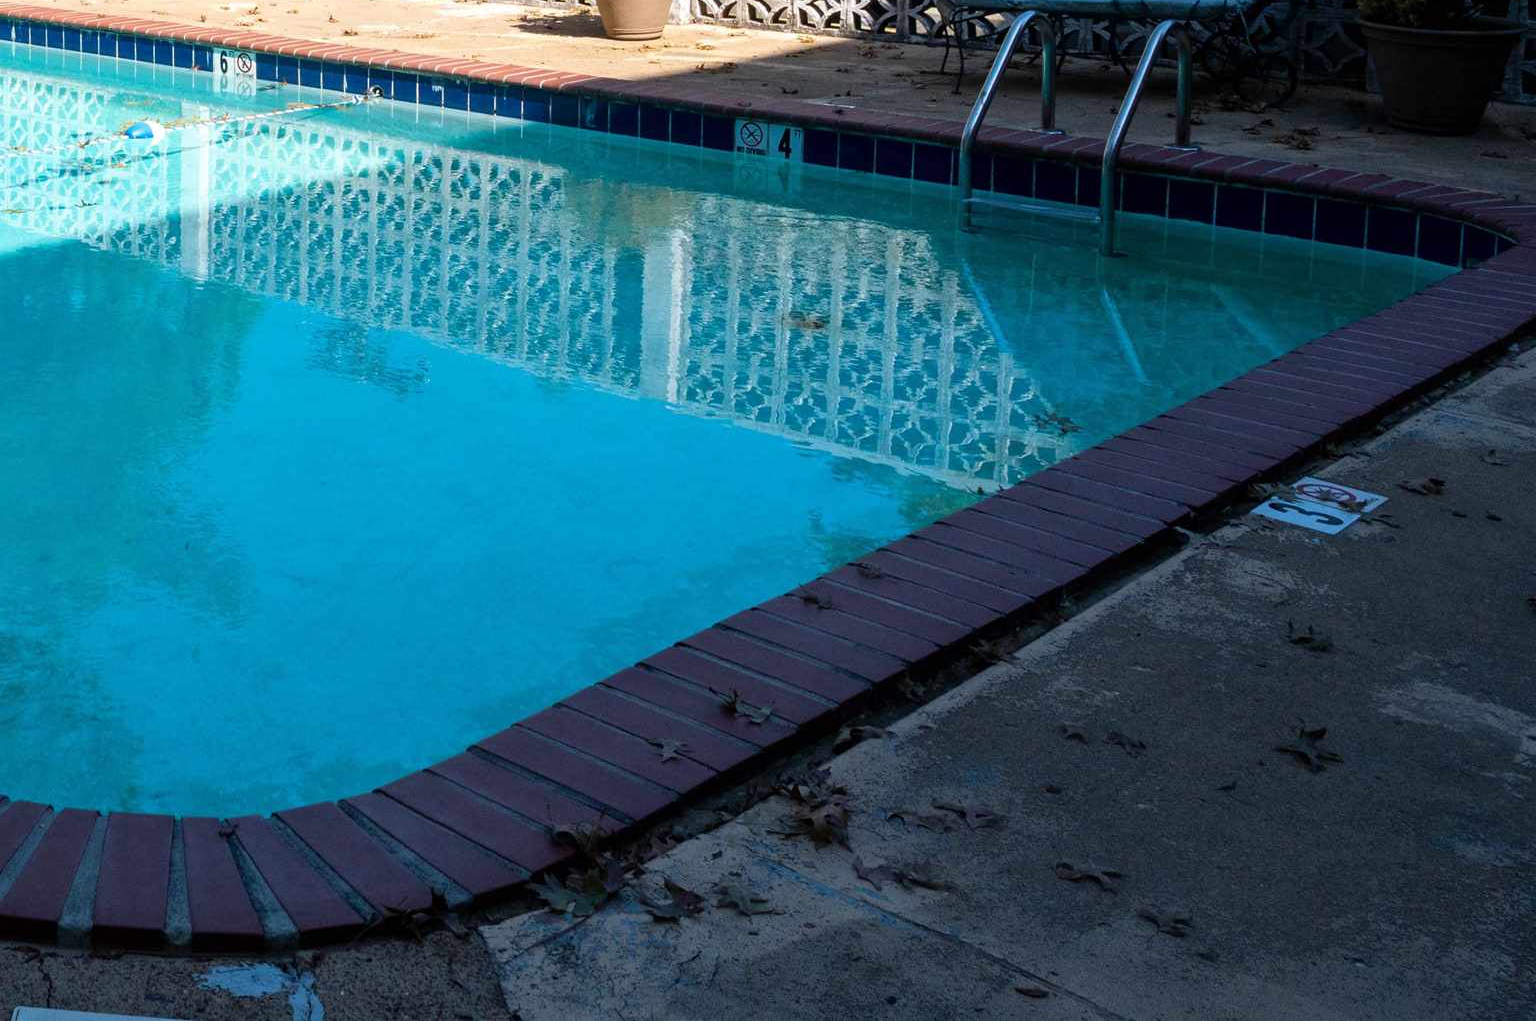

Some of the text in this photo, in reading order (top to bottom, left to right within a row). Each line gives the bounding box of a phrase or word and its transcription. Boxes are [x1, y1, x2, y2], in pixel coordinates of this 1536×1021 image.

[220, 50, 228, 74] 6
[778, 128, 792, 159] 4
[1268, 502, 1345, 526] 3
